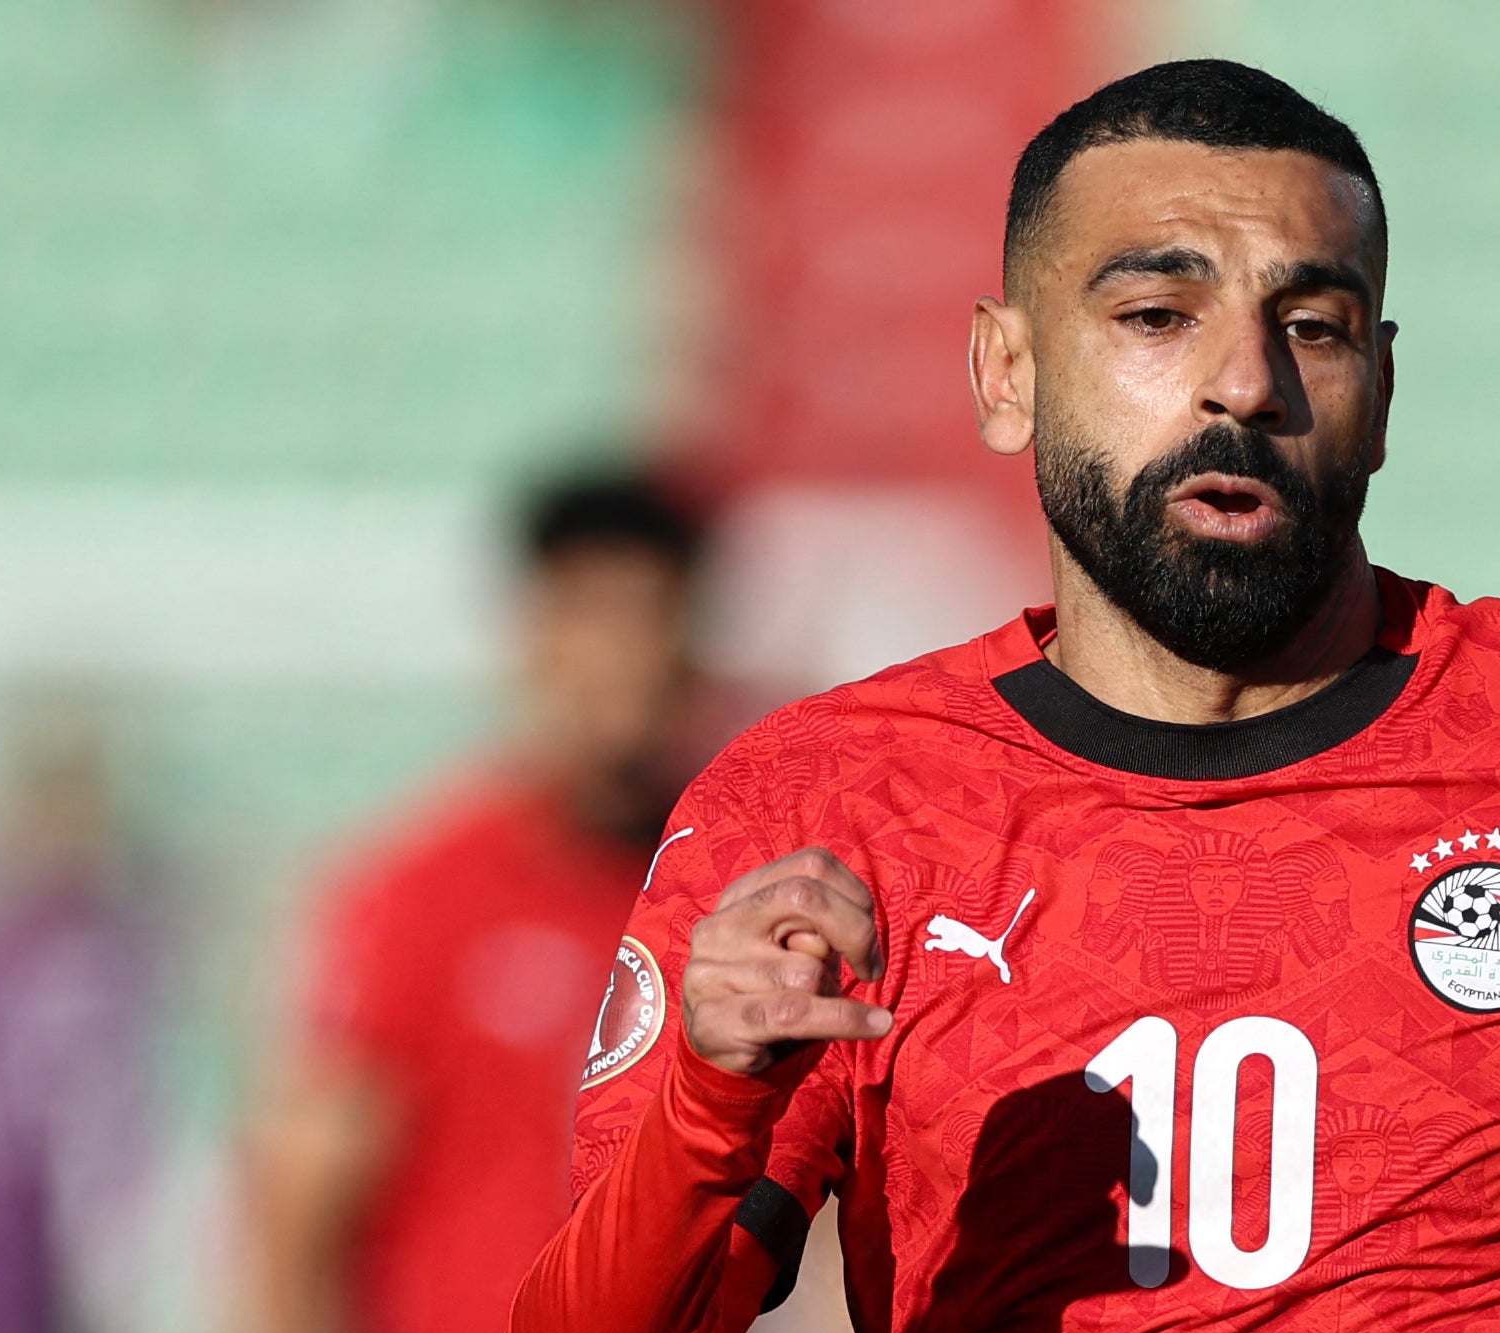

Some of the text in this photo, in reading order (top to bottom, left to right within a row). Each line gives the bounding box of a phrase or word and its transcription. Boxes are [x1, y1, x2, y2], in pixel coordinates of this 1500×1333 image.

[636, 970, 654, 1001] CUP
[638, 1004, 654, 1028] OF
[591, 1026, 647, 1076] NATIONS
[1084, 1015, 1318, 1290] 10
